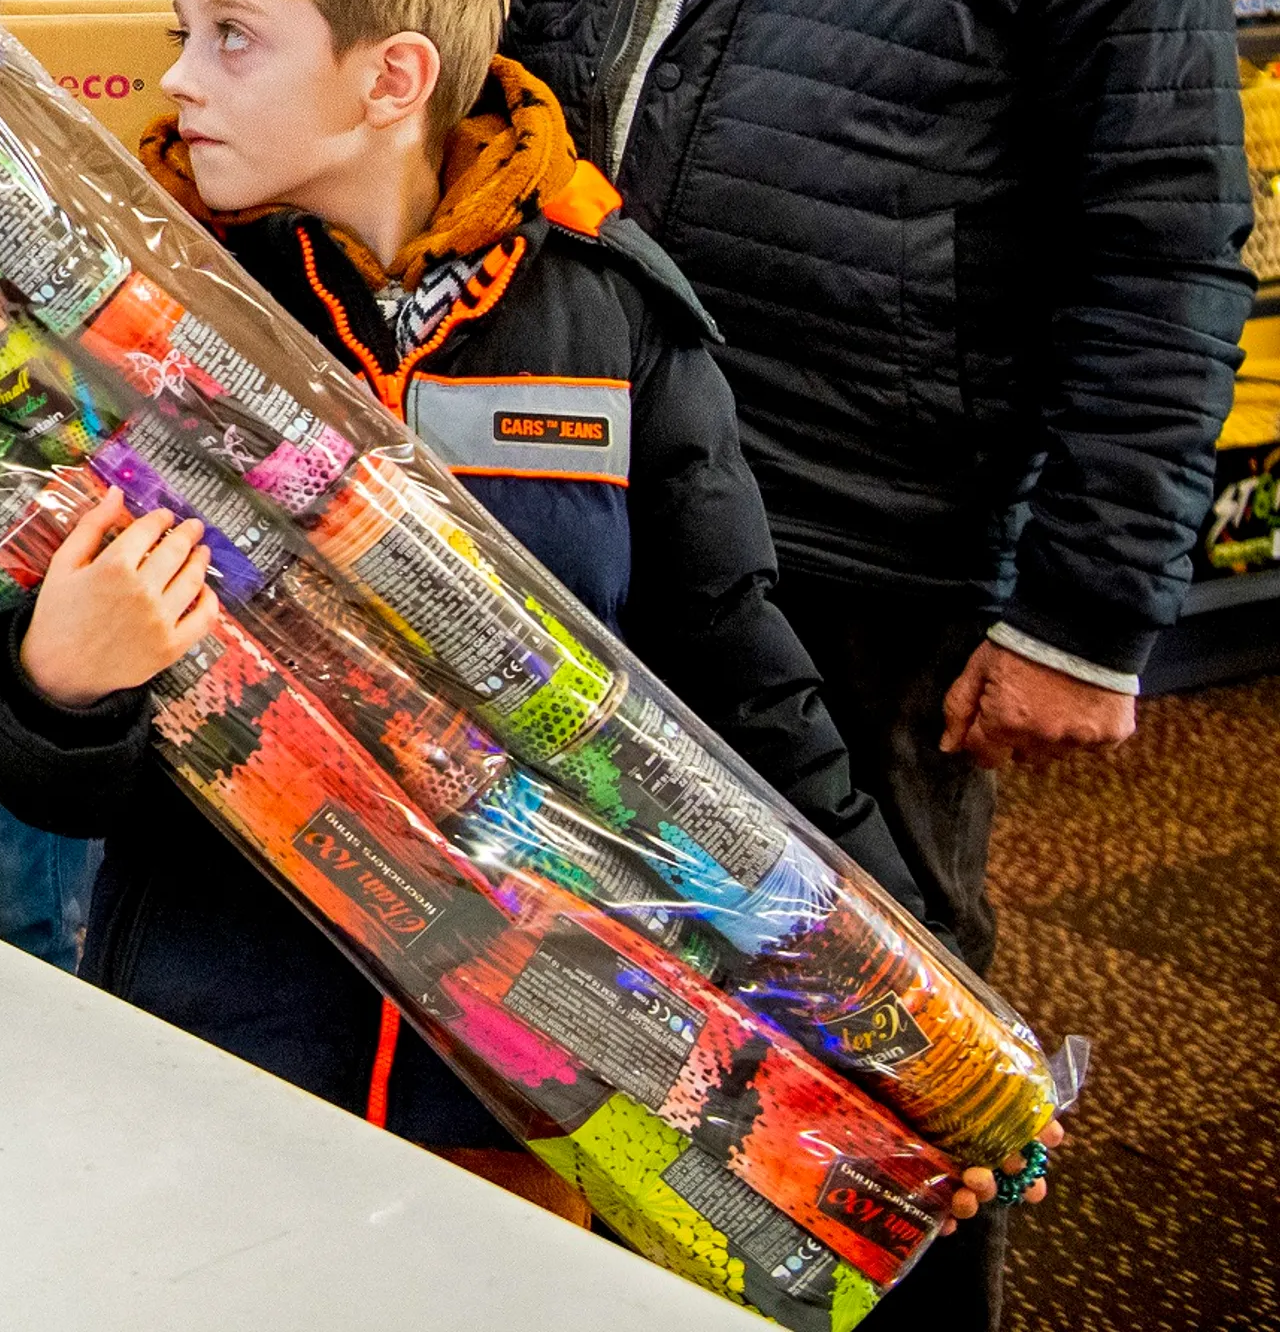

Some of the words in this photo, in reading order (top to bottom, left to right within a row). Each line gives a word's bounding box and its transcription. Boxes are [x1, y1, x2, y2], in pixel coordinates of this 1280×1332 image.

[500, 417, 544, 436] CARS
[559, 421, 603, 440] JEANS
[323, 811, 360, 848] string
[354, 842, 438, 918] firecrackers
